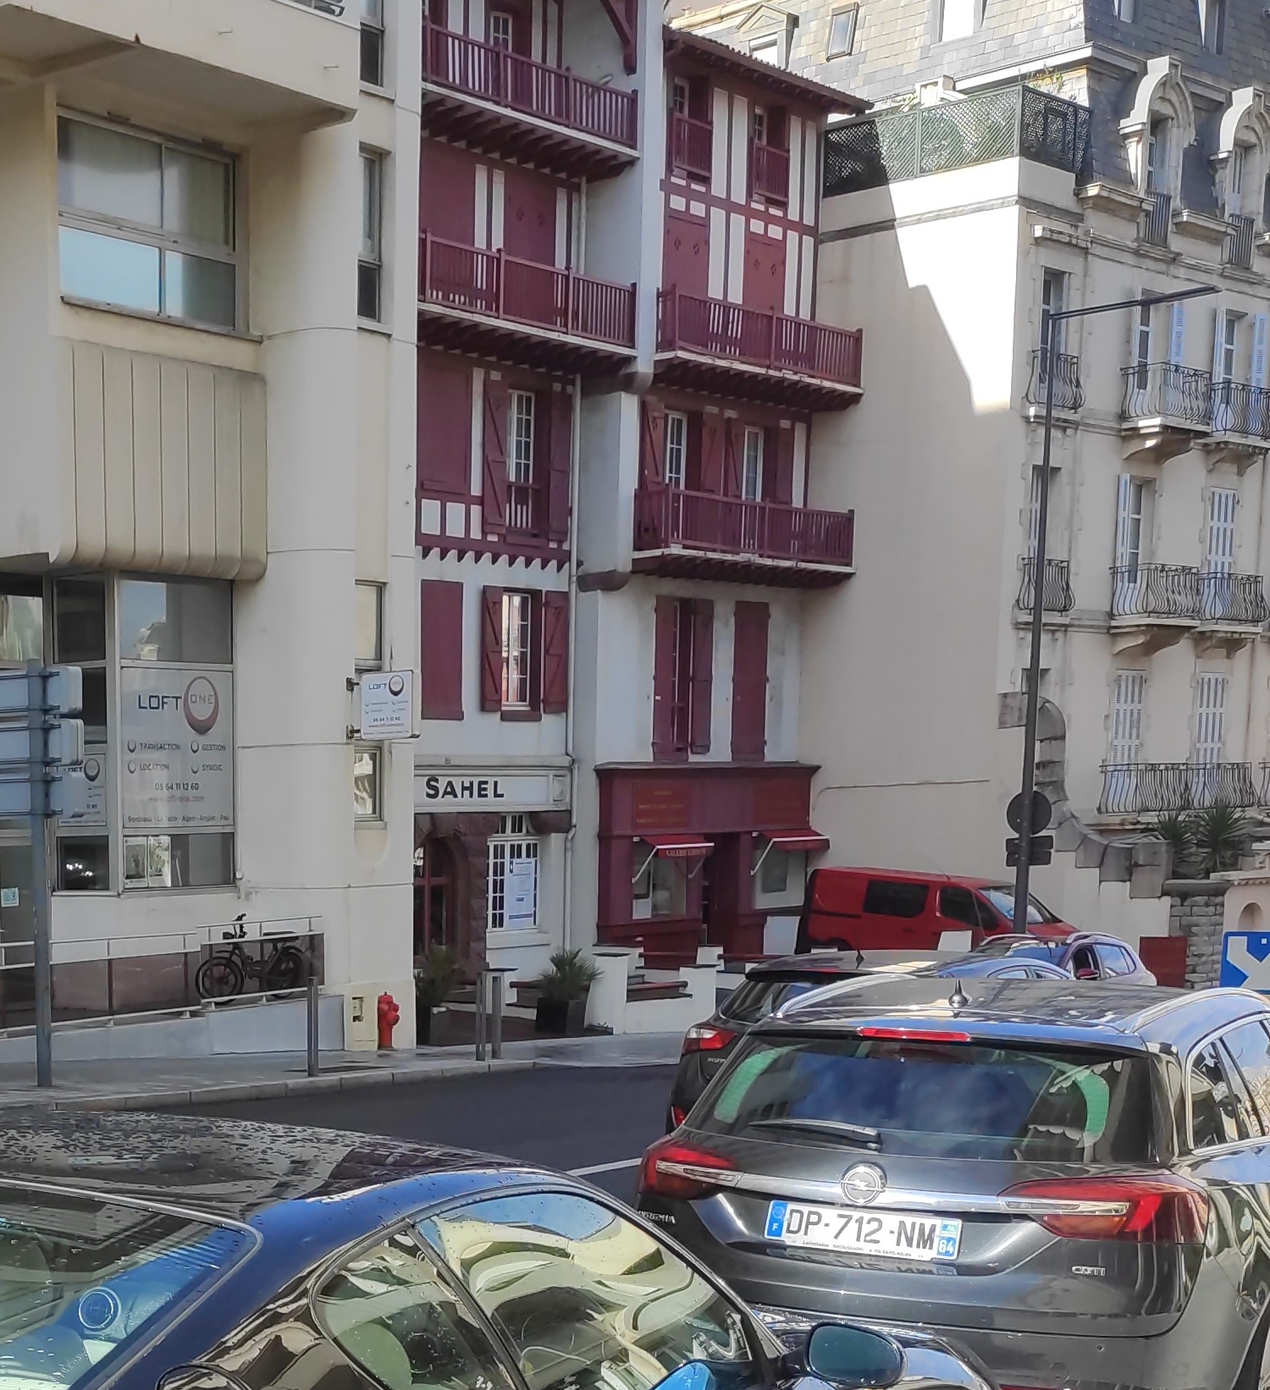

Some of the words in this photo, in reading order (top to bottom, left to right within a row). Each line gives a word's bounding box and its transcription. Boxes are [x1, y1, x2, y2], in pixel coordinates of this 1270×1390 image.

[138, 694, 182, 710] LOFT
[190, 694, 214, 705] ONE
[139, 743, 181, 751] TRANSACTION
[425, 776, 505, 799] SAHEL
[771, 1222, 779, 1232] F
[786, 1208, 937, 1251] DP-712-NM
[939, 1239, 955, 1254] 64
